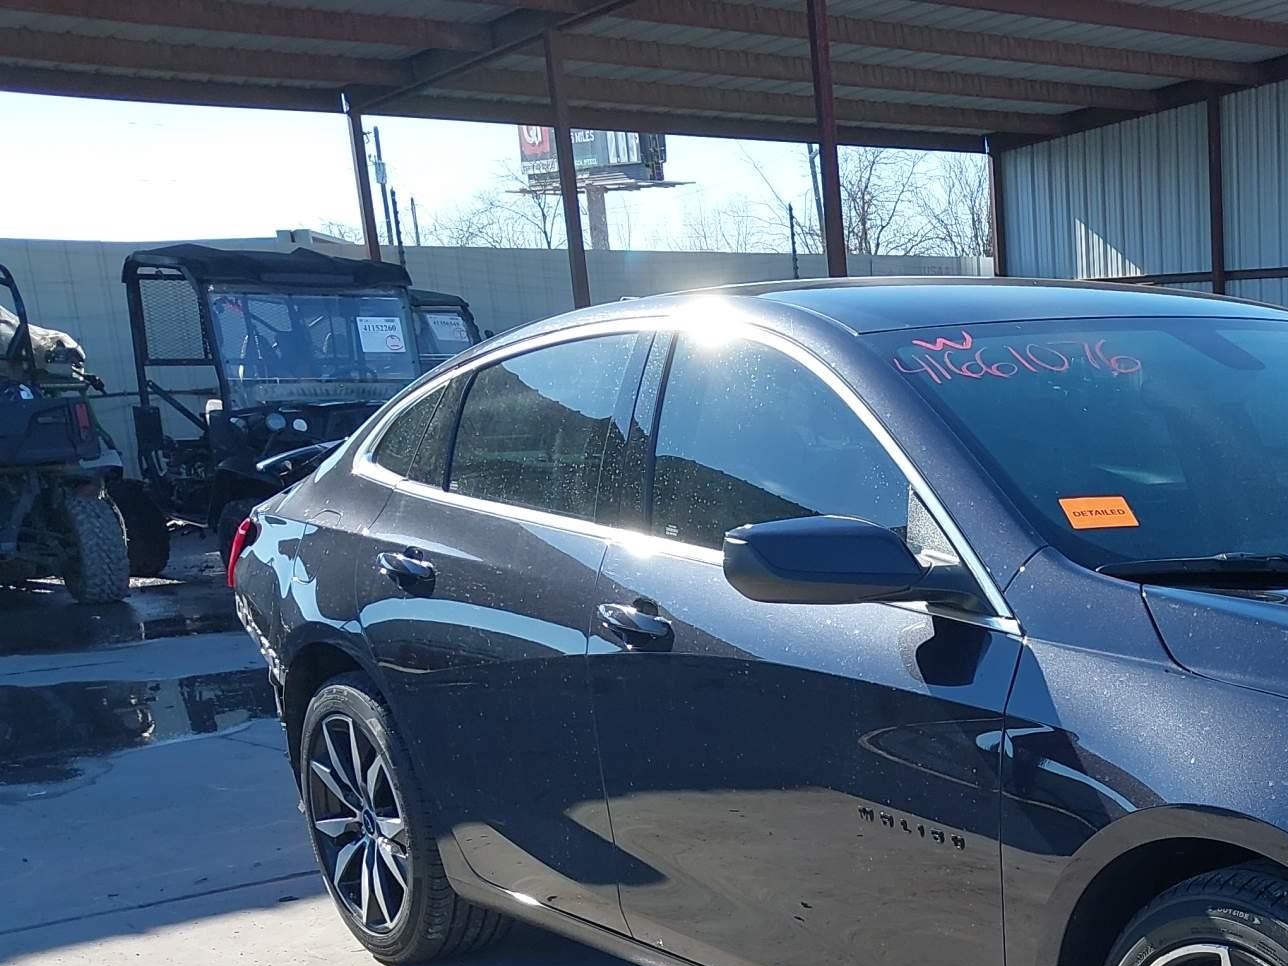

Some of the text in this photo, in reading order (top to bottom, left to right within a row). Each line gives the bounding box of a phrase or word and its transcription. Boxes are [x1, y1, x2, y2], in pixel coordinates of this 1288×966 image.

[1072, 508, 1126, 517] DETAILED
[858, 805, 966, 850] MALIBU
[1217, 907, 1250, 920] OUTSIDE
